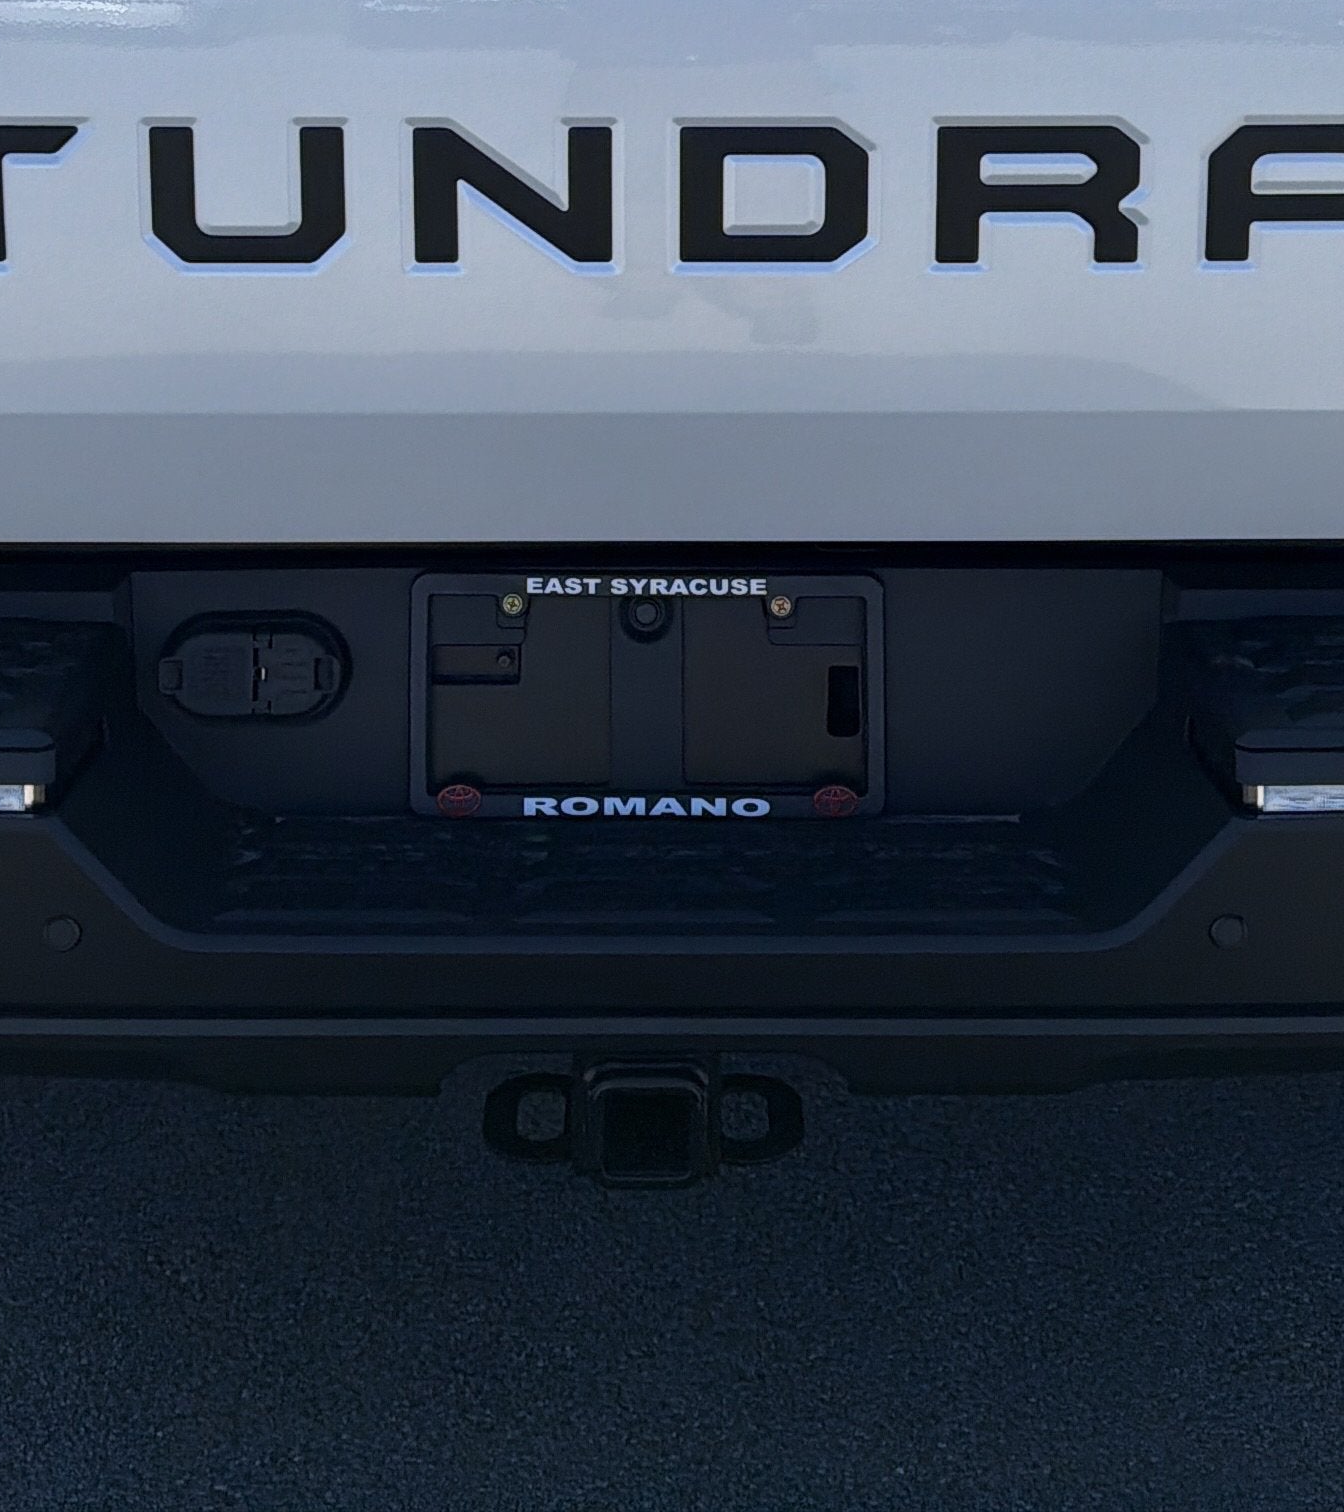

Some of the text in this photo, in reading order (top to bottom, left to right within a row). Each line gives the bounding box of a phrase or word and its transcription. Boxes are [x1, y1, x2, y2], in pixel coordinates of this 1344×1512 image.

[526, 577, 767, 595] EAST SYRACUSE
[523, 796, 771, 817] ROMANO
